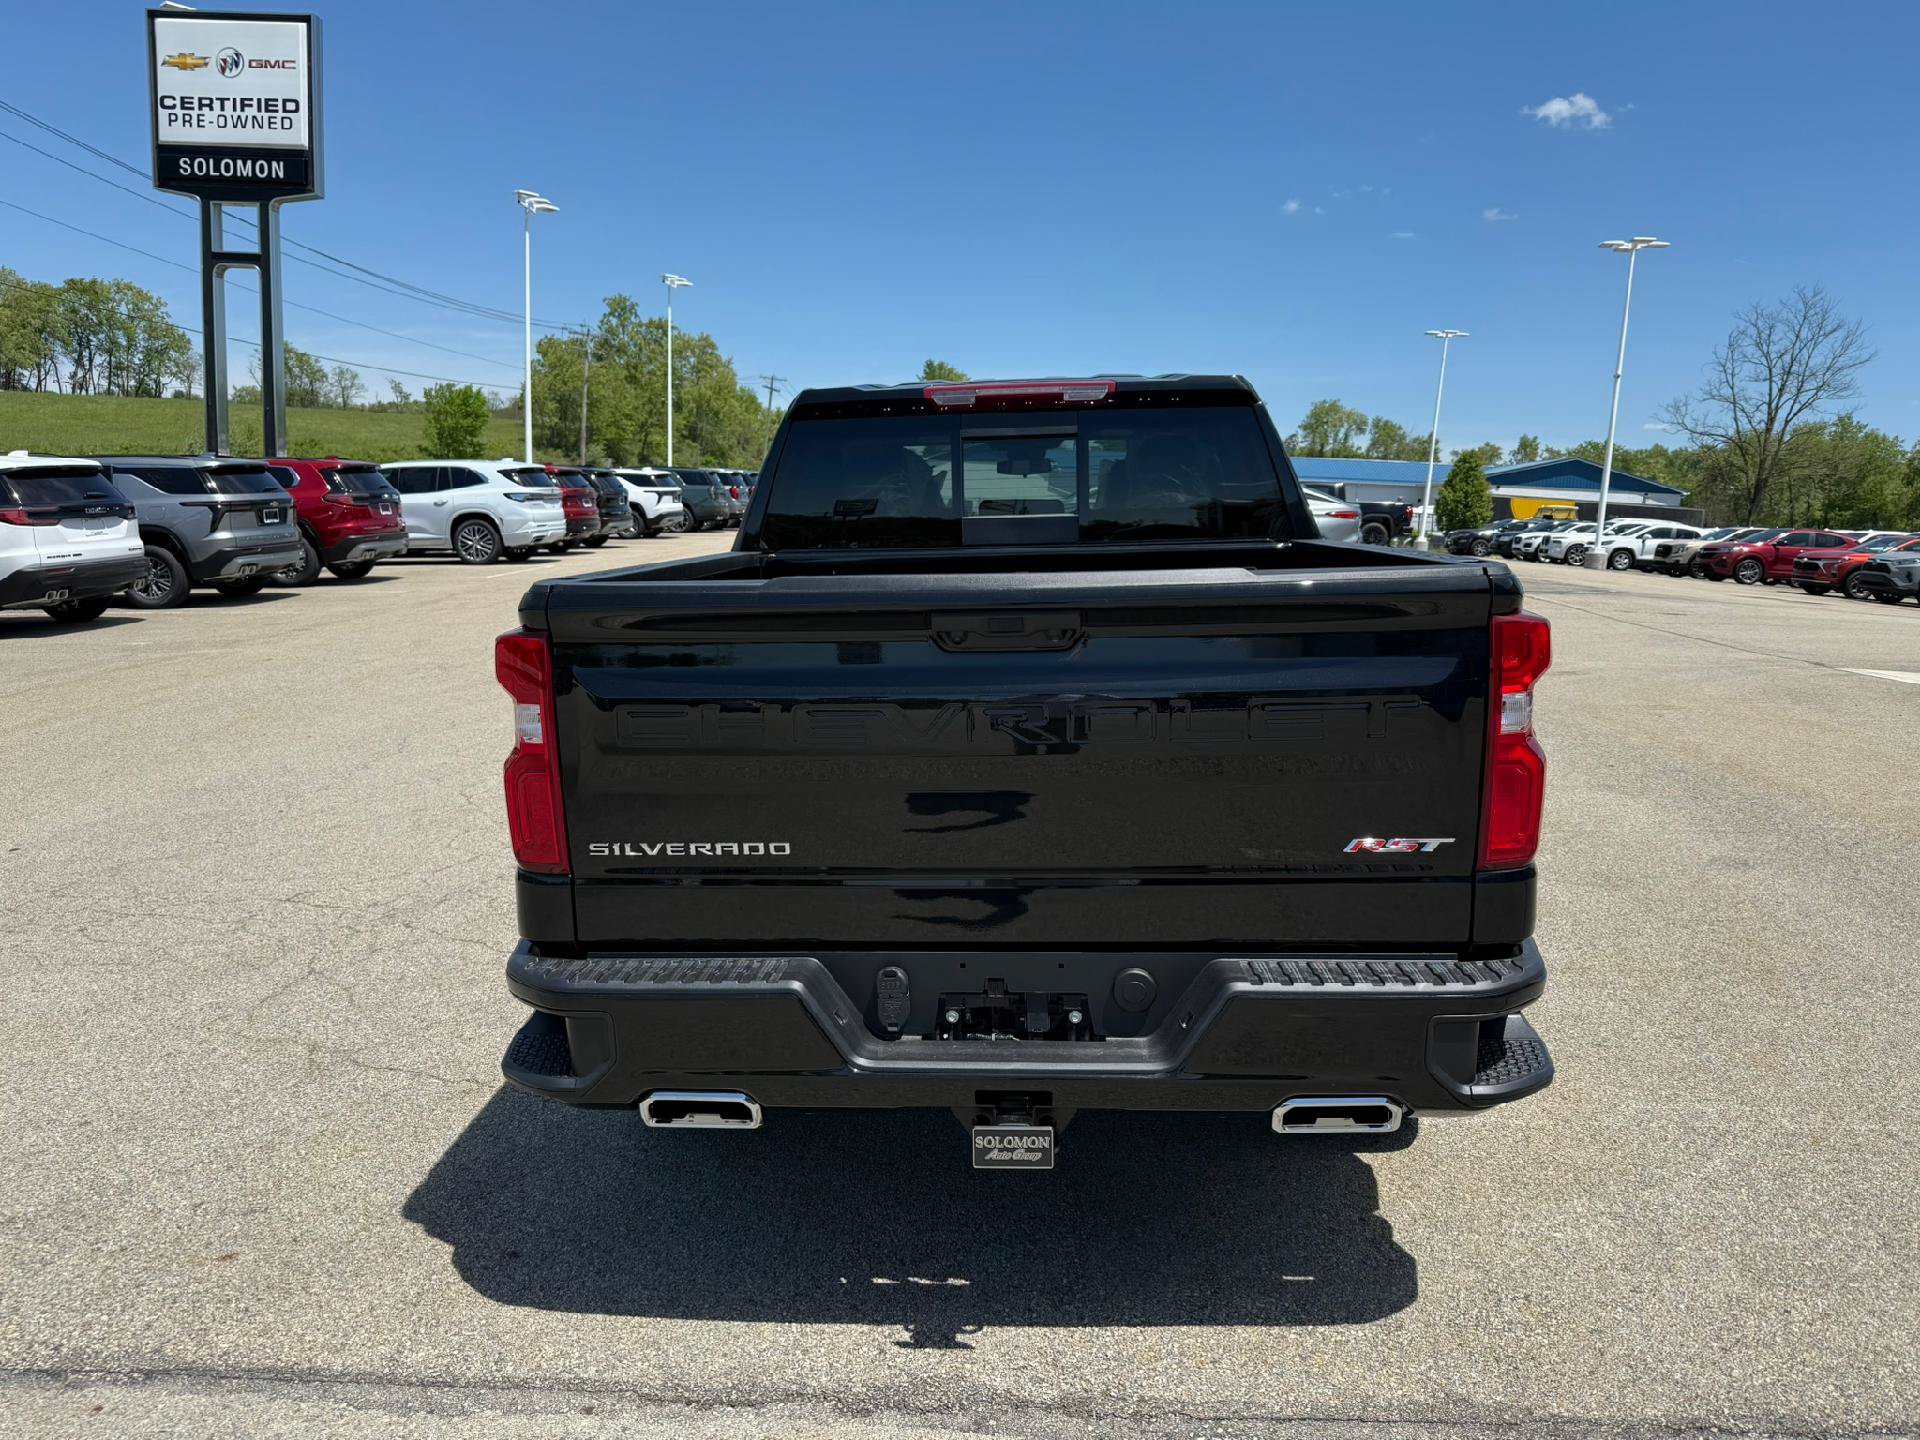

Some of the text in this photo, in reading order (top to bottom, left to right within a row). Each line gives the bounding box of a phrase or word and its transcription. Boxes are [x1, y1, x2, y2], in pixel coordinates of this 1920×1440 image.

[248, 59, 296, 69] GMC
[159, 95, 300, 114] CERTIFIED
[168, 113, 293, 130] PRE-OWNED
[179, 157, 284, 178] SOLOMON
[612, 698, 1424, 746] CHEVROLET
[588, 842, 791, 856] SILVERADO
[1343, 838, 1456, 852] RST
[975, 1136, 1050, 1148] SOLOMON
[984, 1148, 1042, 1161] Auto Group
